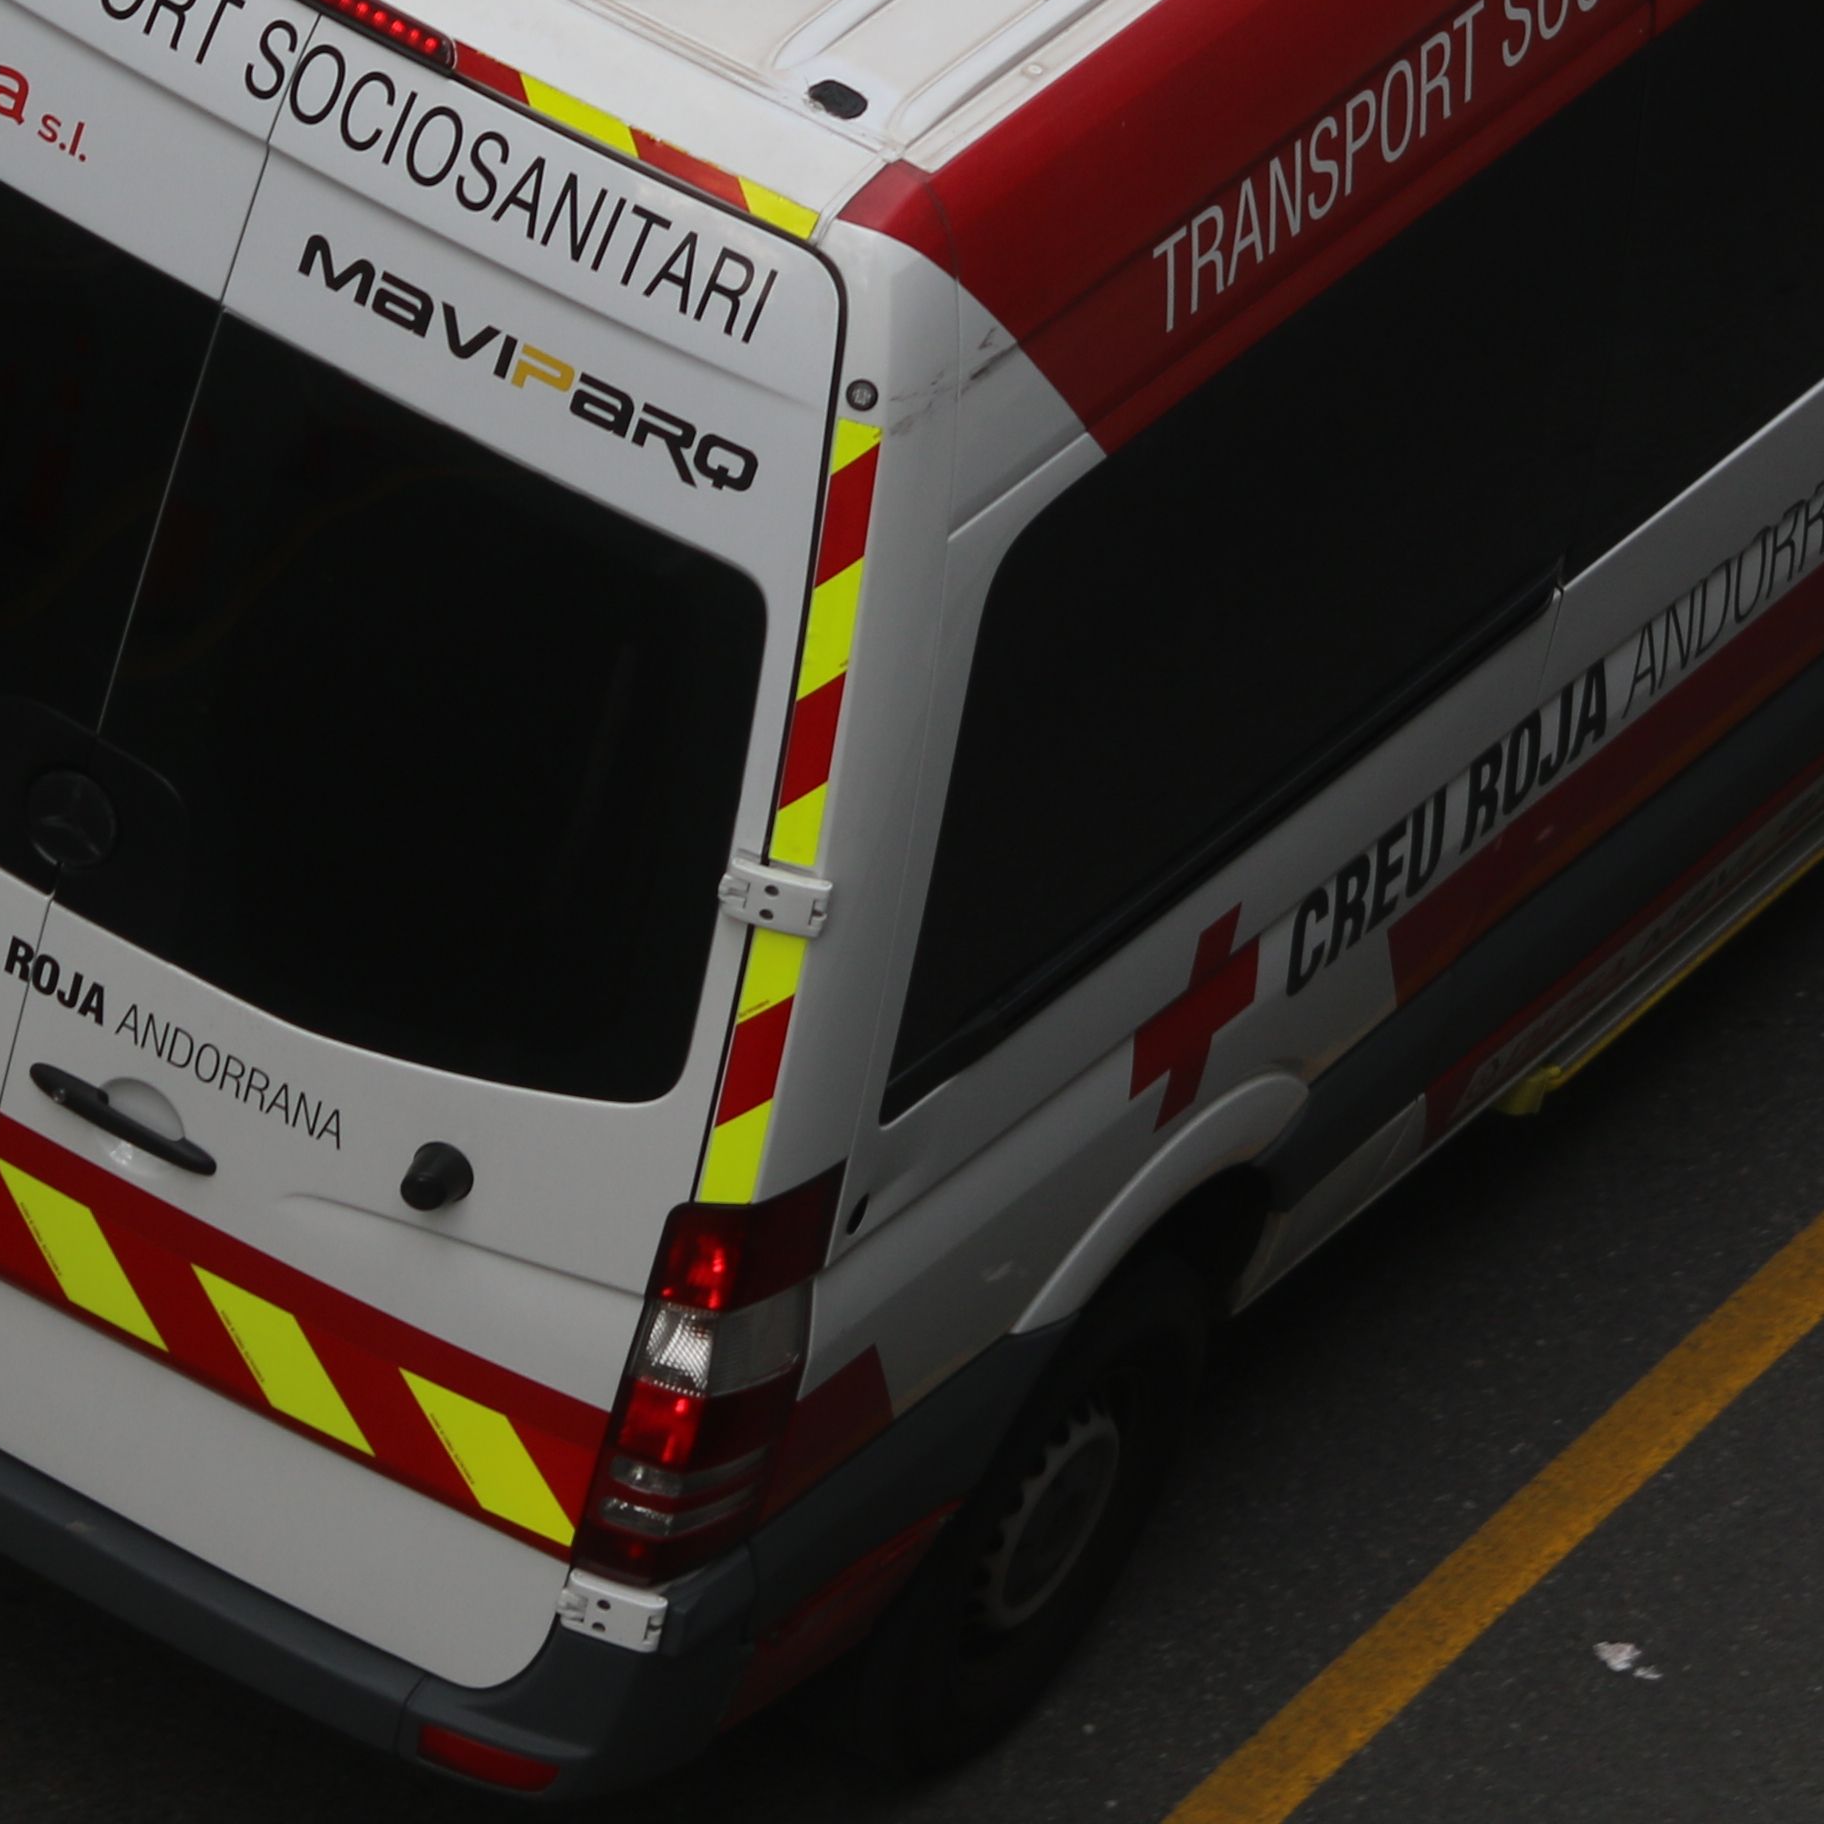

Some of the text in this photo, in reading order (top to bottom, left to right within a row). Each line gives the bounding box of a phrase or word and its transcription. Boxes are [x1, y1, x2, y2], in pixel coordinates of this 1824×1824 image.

[37, 114, 86, 162] s.l.
[244, 20, 779, 344] SOCIOSANITARI
[1285, 793, 1448, 998] CREU
[1459, 657, 1609, 853] ROJA
[3, 935, 106, 1026] ROJA
[114, 1002, 344, 1150] ANDORRANA
